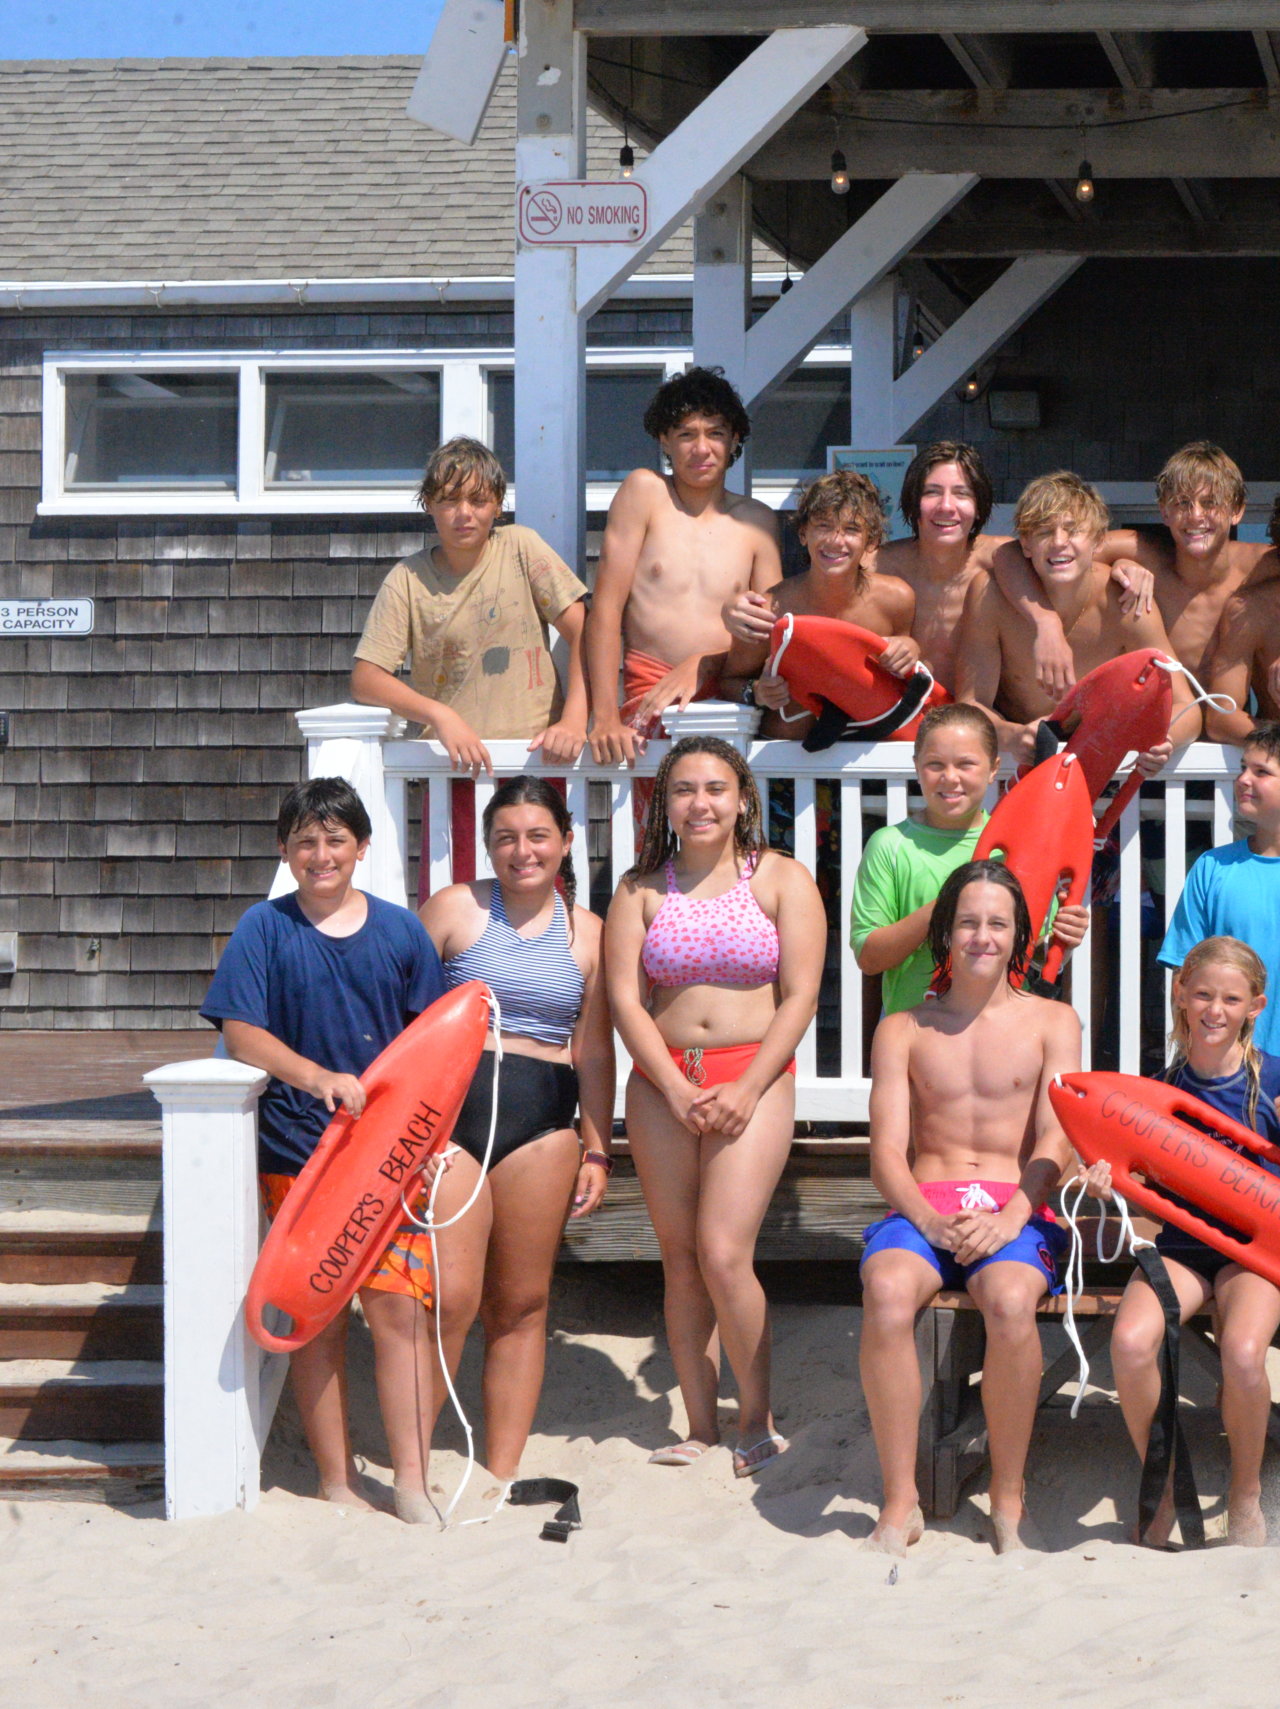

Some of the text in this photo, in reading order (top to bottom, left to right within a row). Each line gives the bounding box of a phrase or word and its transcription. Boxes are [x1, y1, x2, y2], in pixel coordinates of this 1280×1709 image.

[567, 205, 640, 225] NO SMOKING
[1, 607, 79, 617] 3 PERSON
[3, 619, 75, 629] CAPACITY
[1101, 1090, 1214, 1168] COOPER'S
[309, 1101, 442, 1294] COOPER'S BEACH
